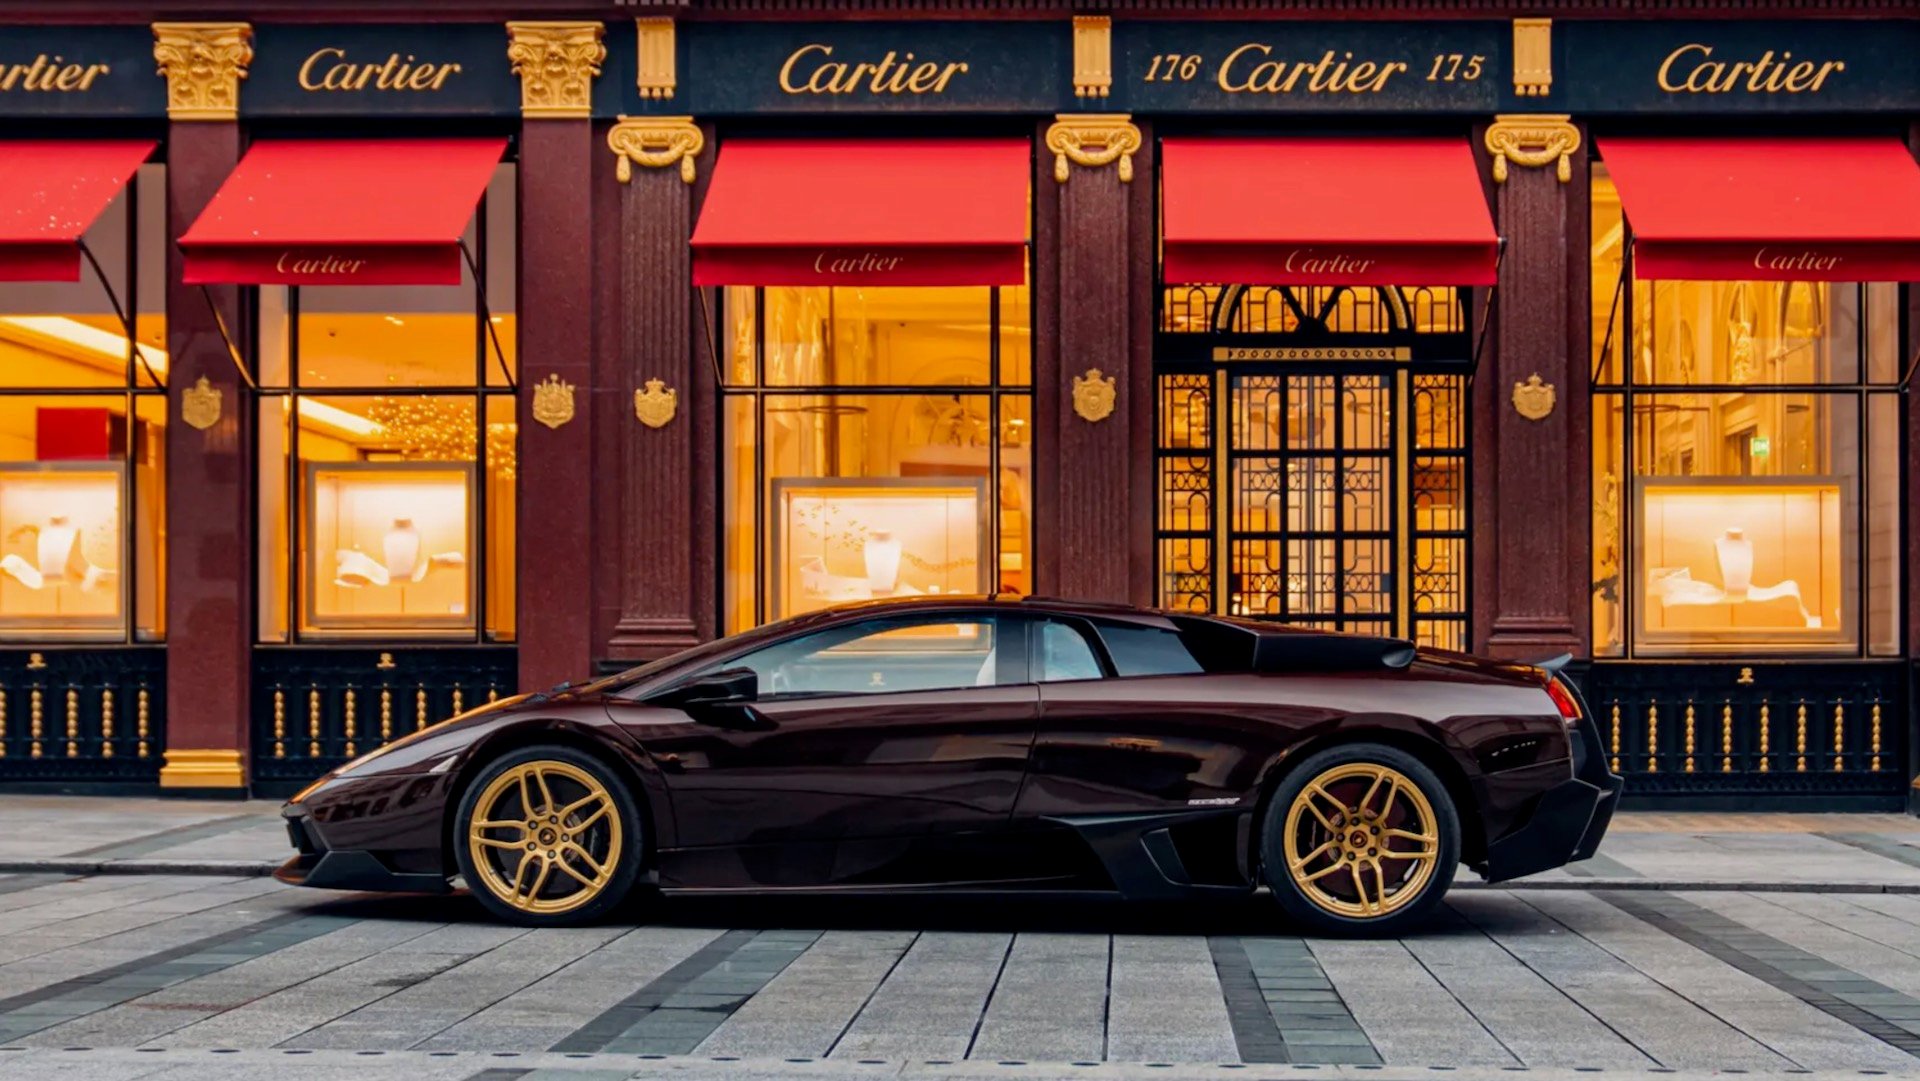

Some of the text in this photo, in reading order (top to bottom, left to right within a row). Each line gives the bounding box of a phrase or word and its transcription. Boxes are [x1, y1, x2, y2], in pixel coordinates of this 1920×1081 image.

[0, 54, 109, 91] rtier
[298, 47, 461, 92] Cartier
[779, 43, 969, 94] Cartier
[1144, 43, 1485, 93] 176 Cartier 175
[1657, 43, 1846, 93] Cartier
[276, 250, 367, 274] Cartier
[814, 249, 904, 274] Cartier
[1285, 248, 1375, 273] Cartier
[1754, 246, 1843, 271] Cartier
